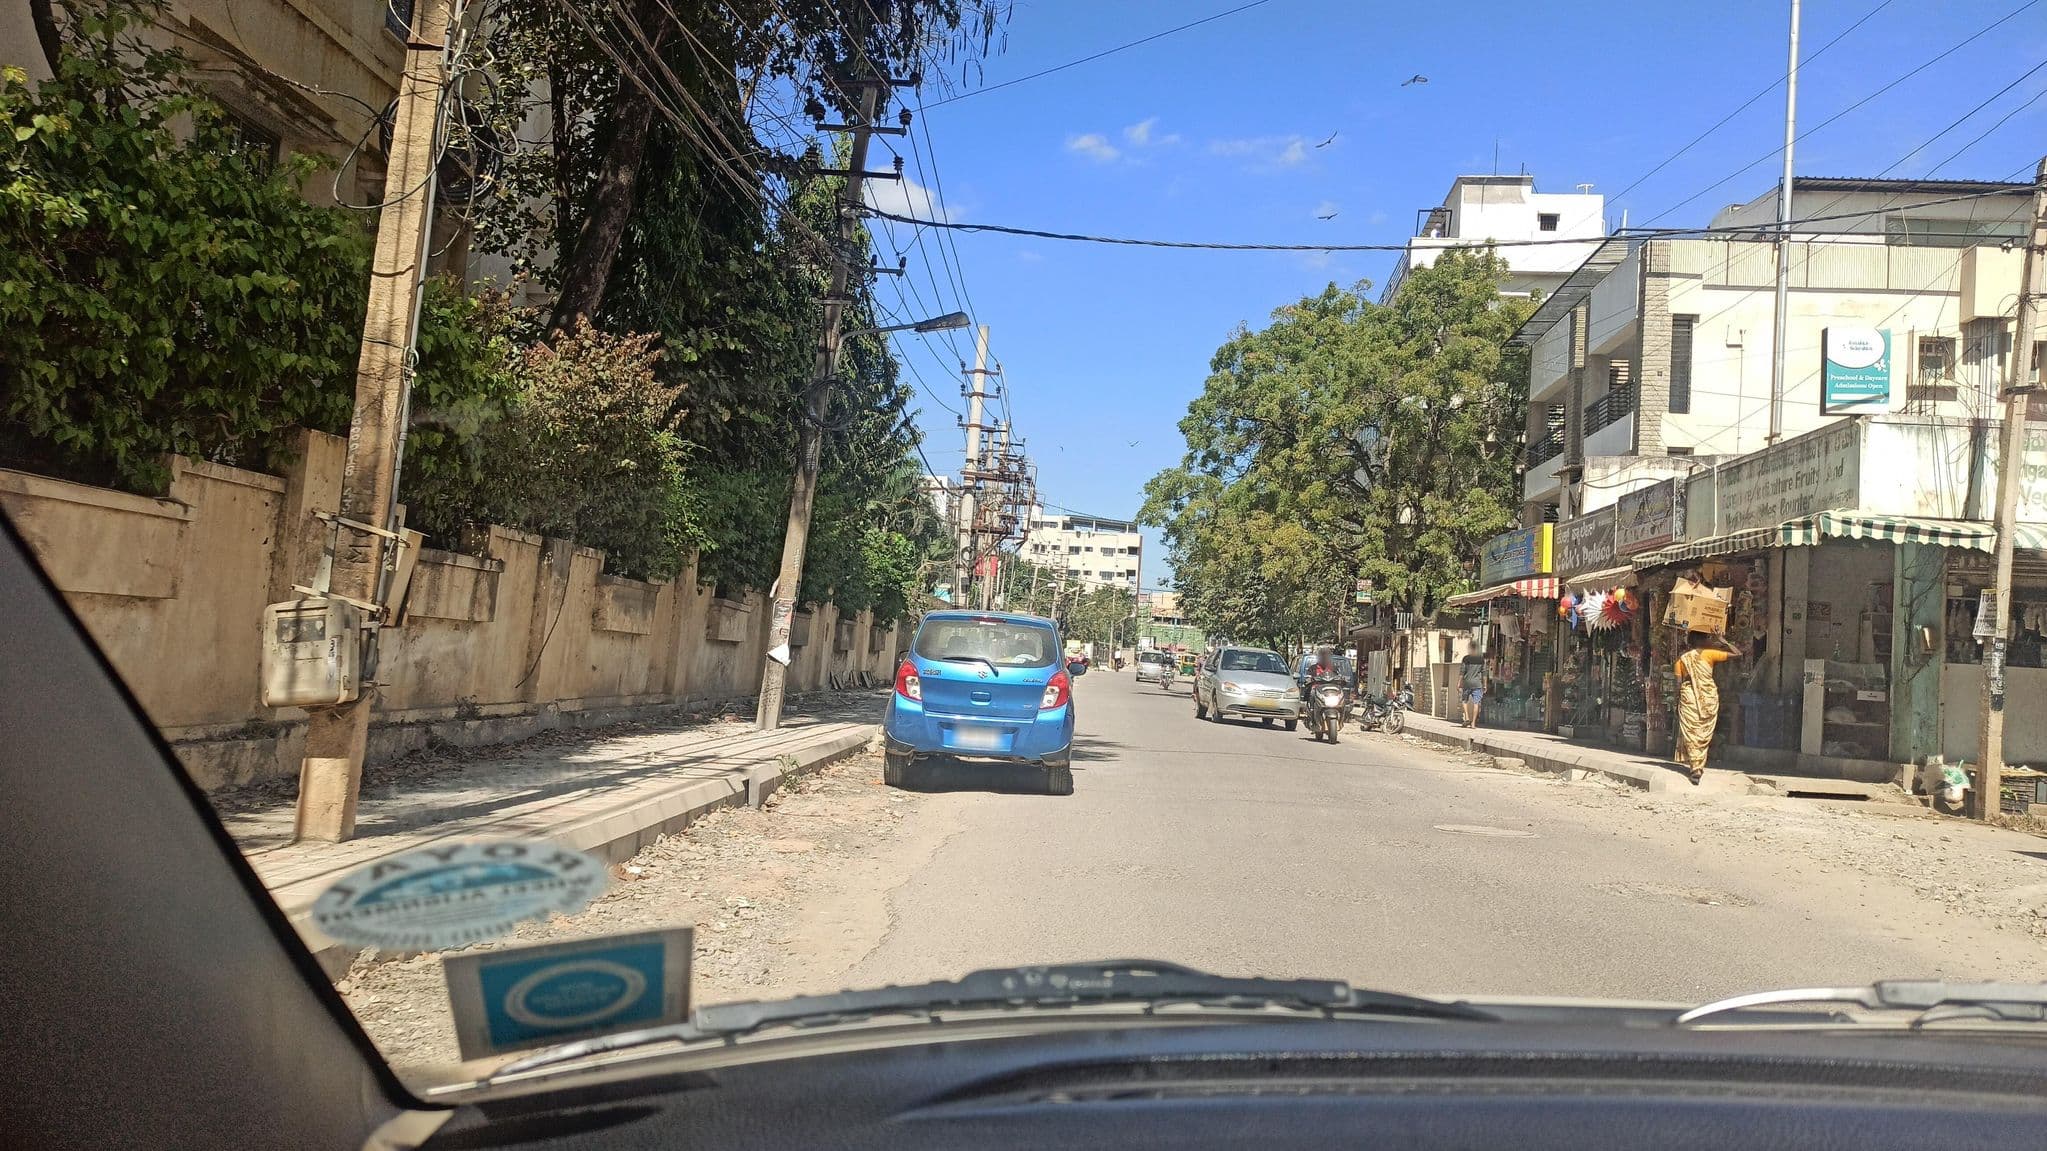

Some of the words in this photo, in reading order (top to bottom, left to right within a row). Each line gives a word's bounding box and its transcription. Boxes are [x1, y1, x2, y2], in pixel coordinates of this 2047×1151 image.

[1830, 373, 1858, 381] Preschool
[1865, 374, 1888, 383] Daycare
[1868, 382, 1884, 391] Open
